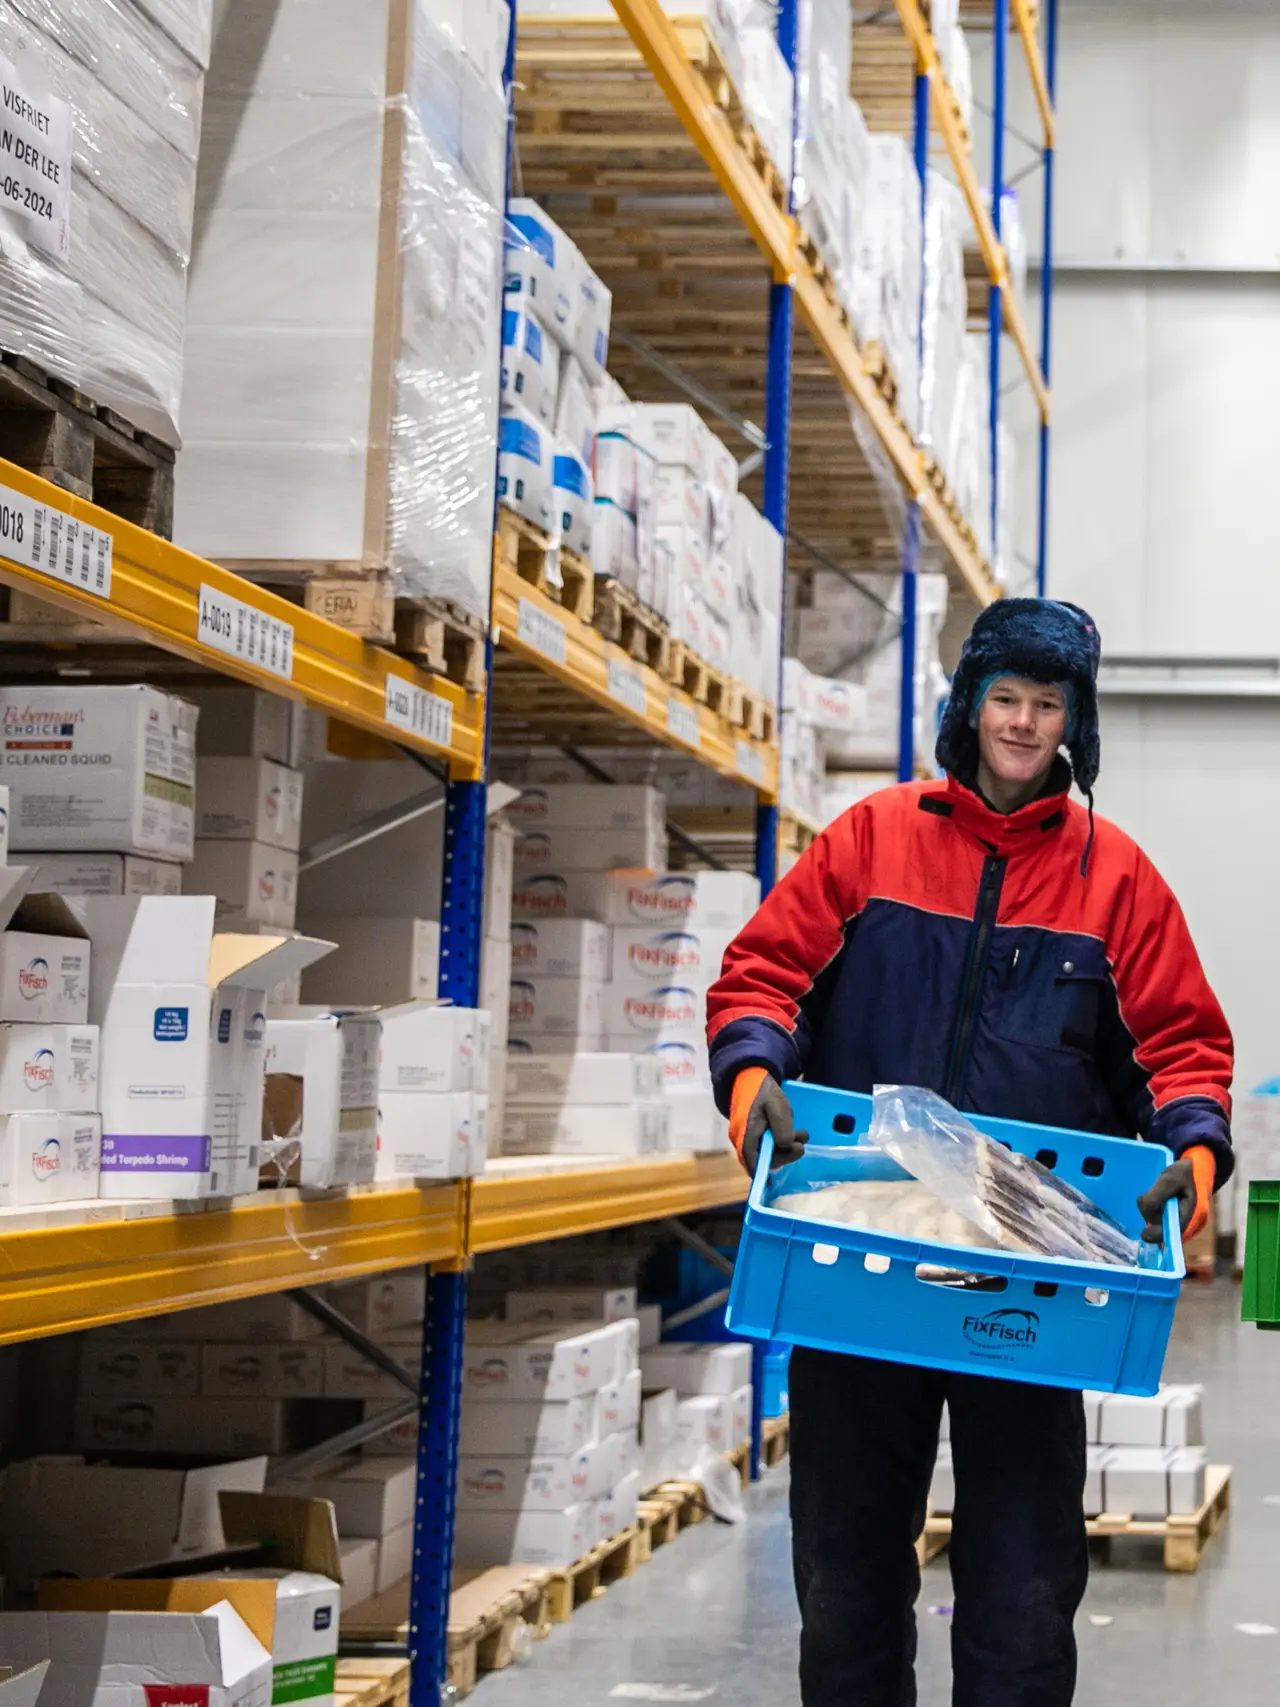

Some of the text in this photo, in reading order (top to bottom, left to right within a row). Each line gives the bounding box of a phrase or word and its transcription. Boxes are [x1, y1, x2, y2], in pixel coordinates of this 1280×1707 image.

[3, 85, 51, 136] VISFRIET
[15, 138, 39, 171] DER
[42, 156, 60, 185] LEE
[0, 504, 24, 544] 018
[201, 600, 232, 638] A-0019
[4, 724, 61, 736] CHOICE
[6, 754, 112, 766] CLEANED SQUID
[19, 969, 48, 990] FixFisch
[24, 1061, 54, 1082] FixFisch
[32, 1152, 61, 1171] FixFisch
[118, 1154, 155, 1168] Torpedo
[156, 1154, 189, 1168] Shrimp
[963, 1315, 1037, 1343] FixFisch
